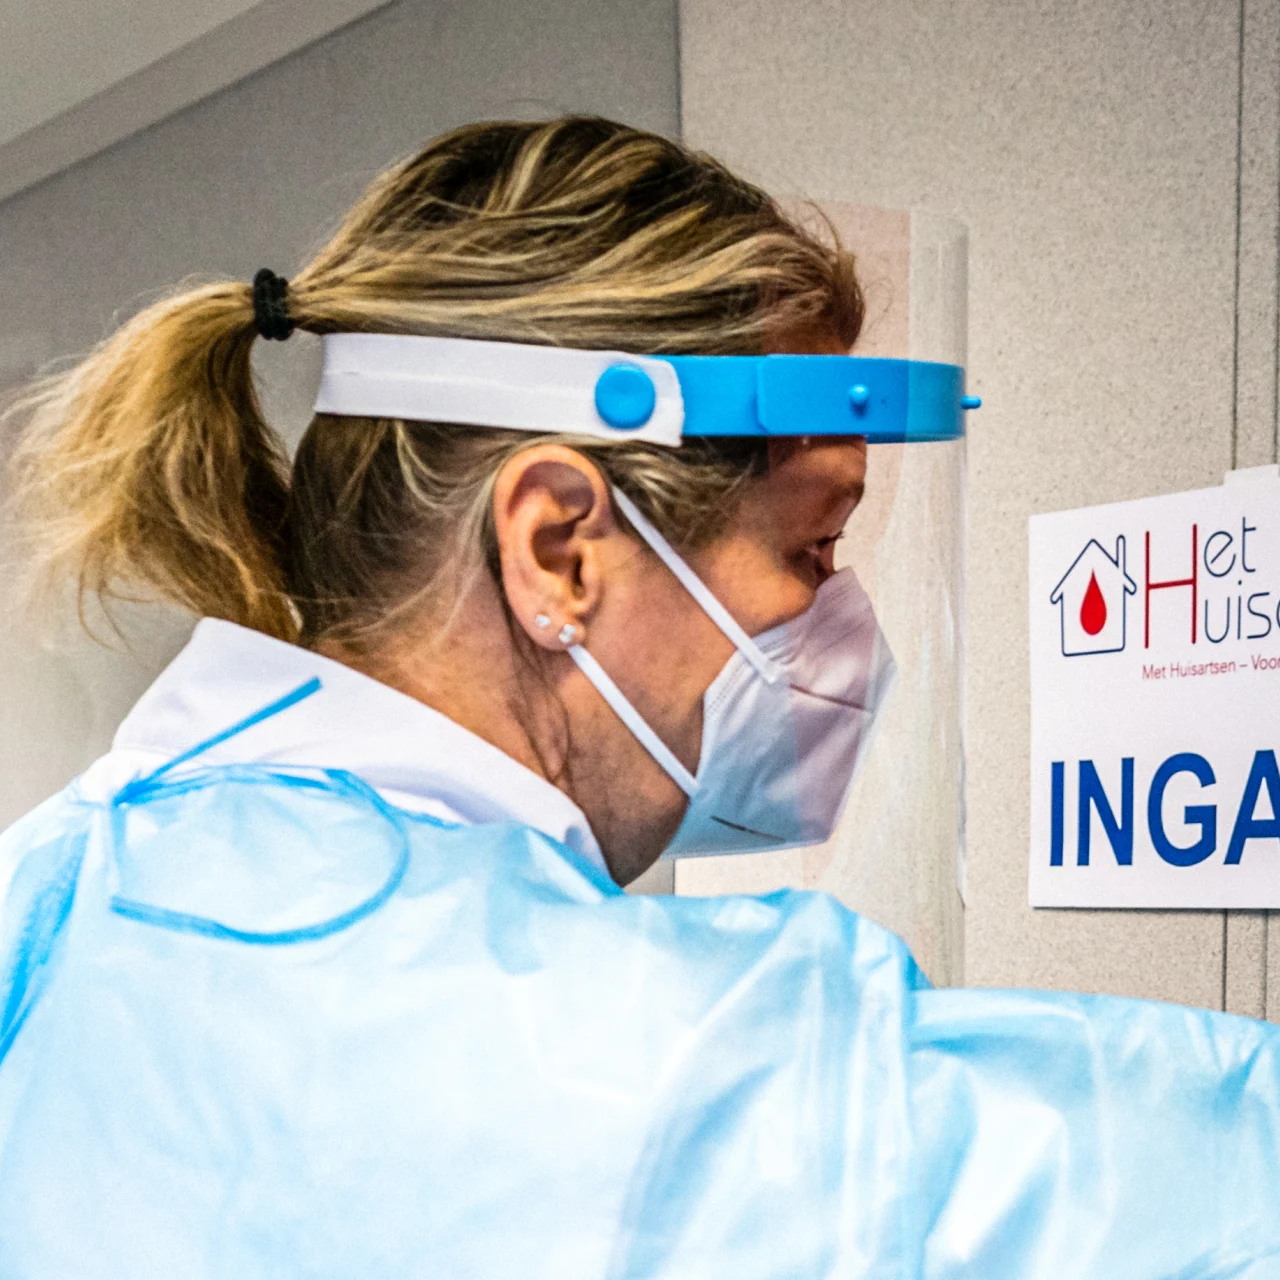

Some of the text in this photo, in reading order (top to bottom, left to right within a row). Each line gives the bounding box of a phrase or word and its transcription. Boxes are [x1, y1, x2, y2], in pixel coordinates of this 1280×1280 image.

[1144, 516, 1257, 649] Het
[1141, 663, 1167, 681] Met
[1169, 659, 1237, 679] Huisartsen
